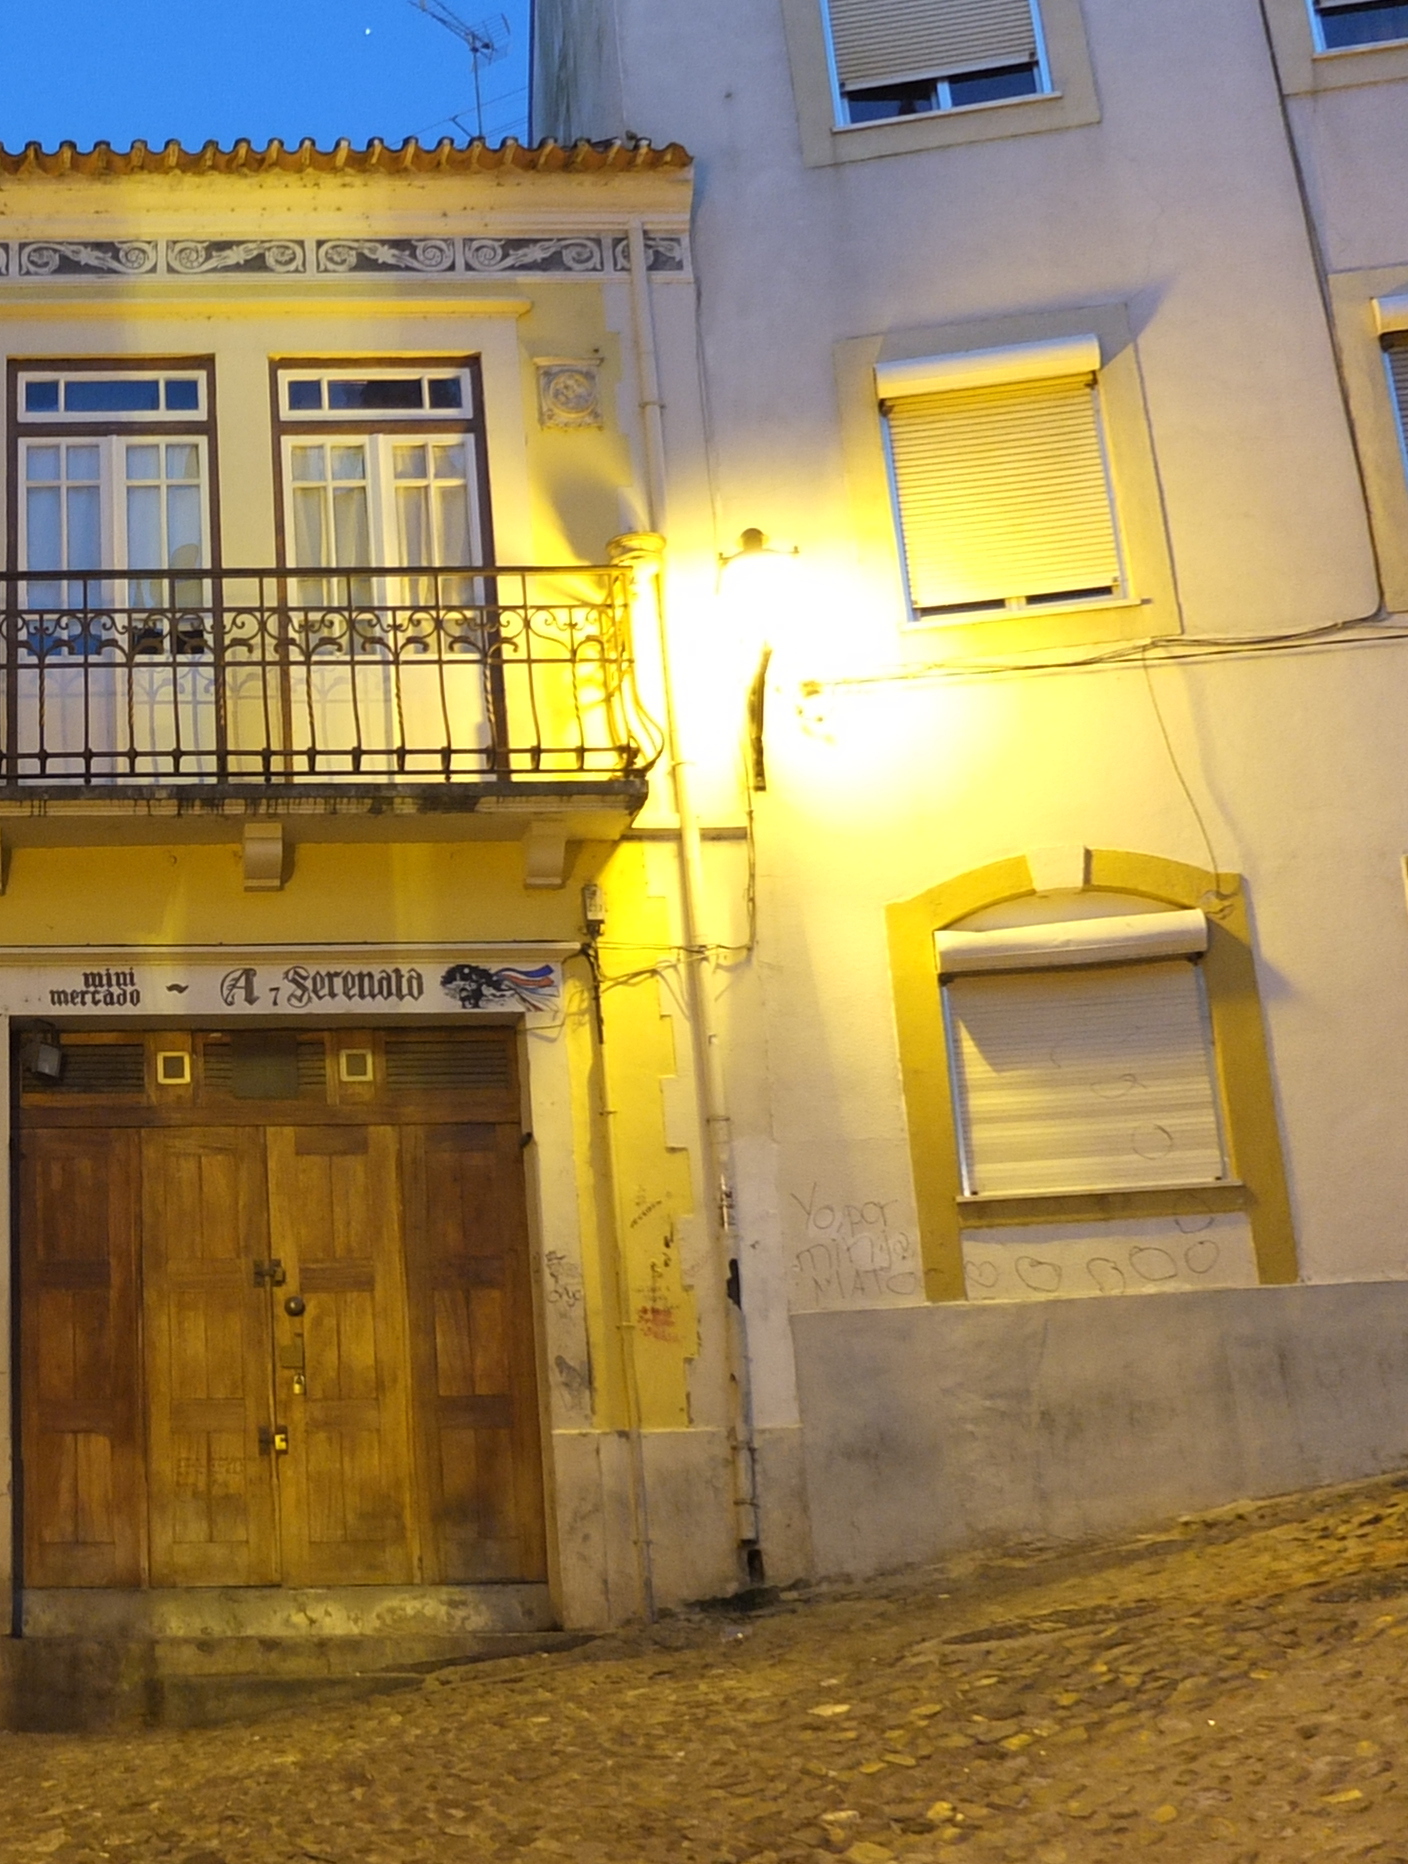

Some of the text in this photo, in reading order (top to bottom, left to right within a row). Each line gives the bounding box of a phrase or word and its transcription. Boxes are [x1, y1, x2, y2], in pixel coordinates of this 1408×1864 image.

[82, 966, 136, 989] mini
[220, 965, 424, 1009] A Serenata
[49, 985, 141, 1007] mercado
